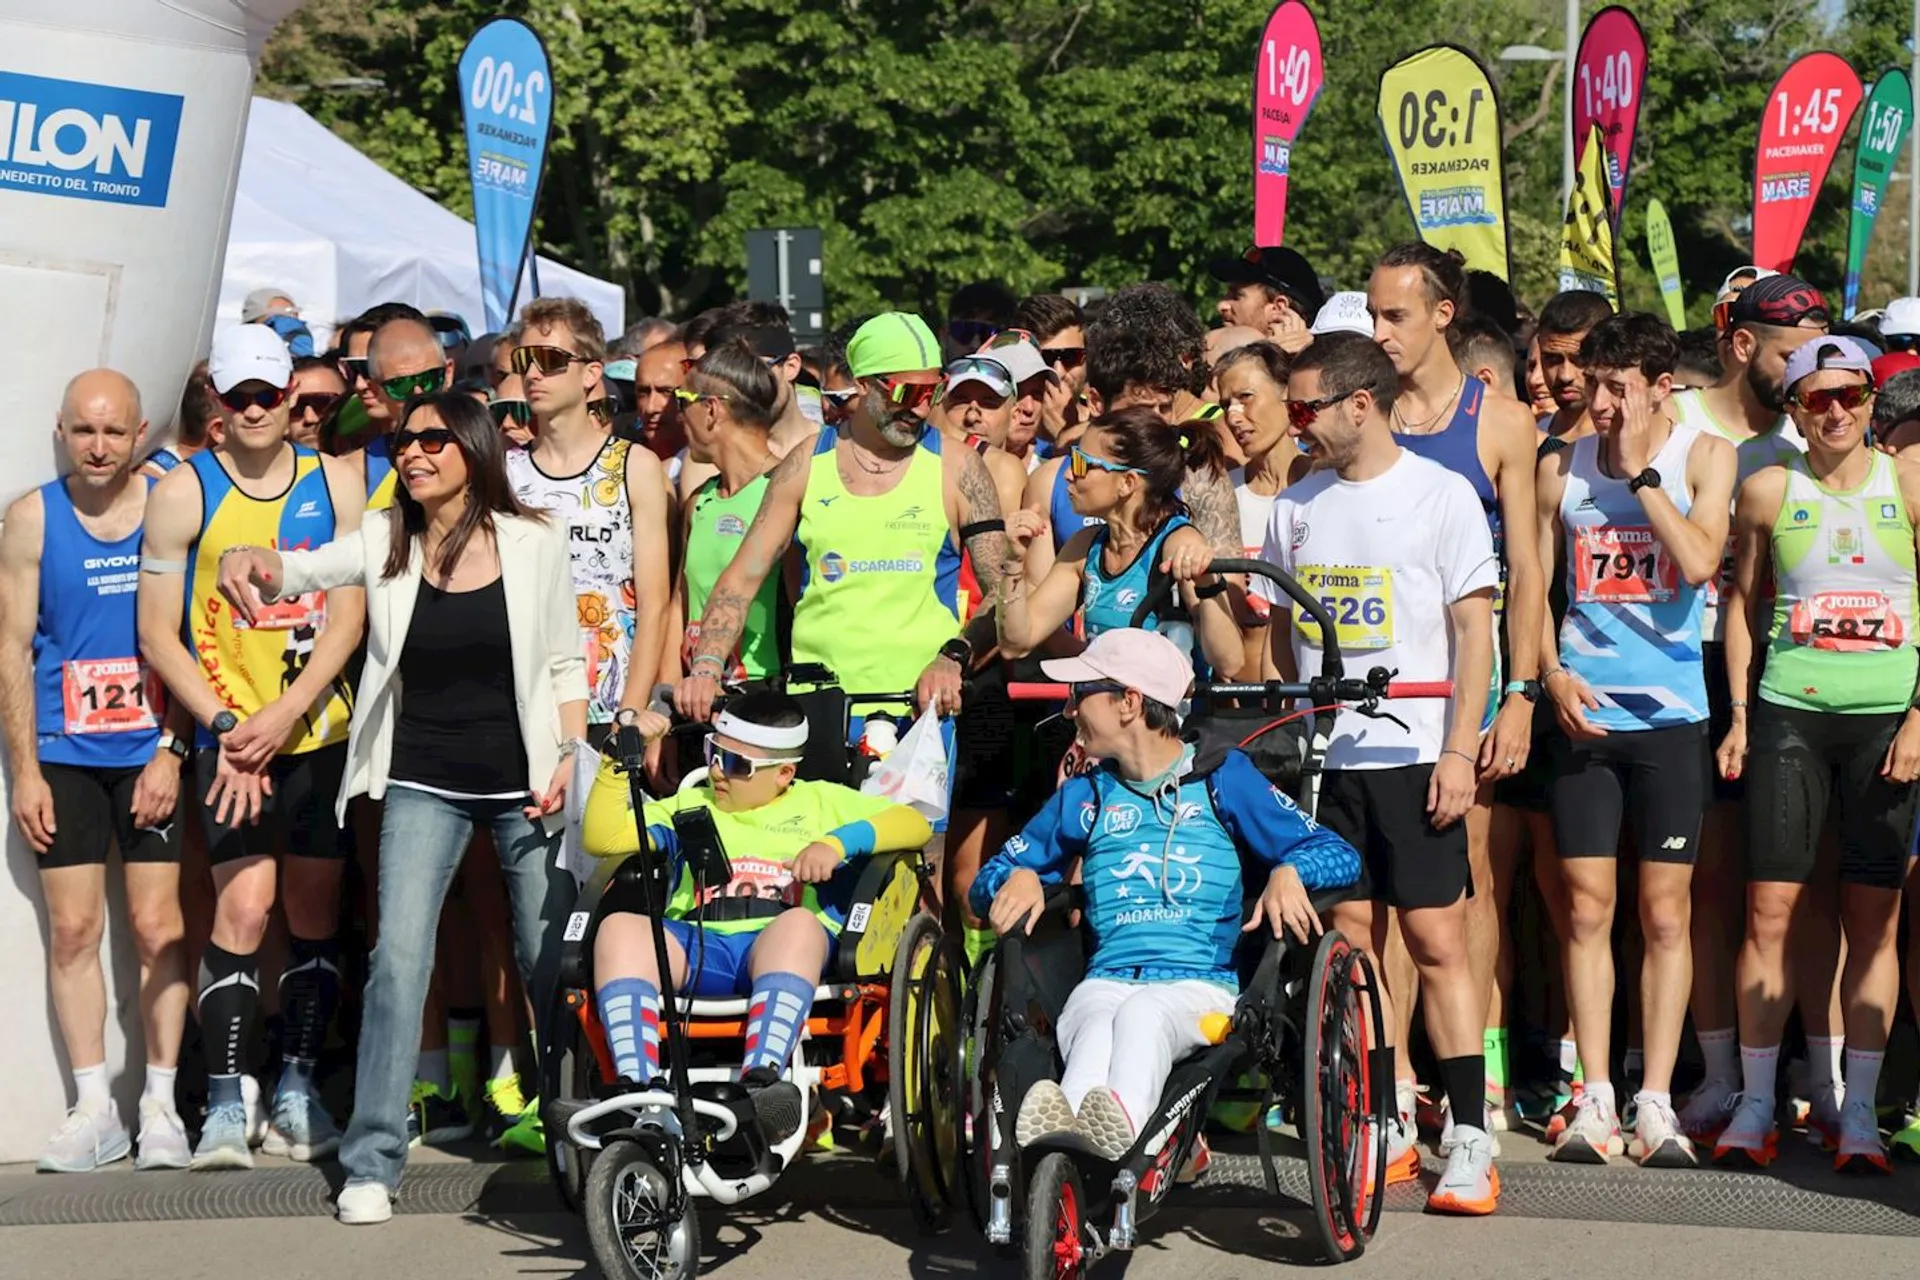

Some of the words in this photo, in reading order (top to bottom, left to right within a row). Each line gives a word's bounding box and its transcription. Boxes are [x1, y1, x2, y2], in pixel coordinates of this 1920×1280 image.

[1267, 39, 1310, 106] 1:40
[1580, 50, 1633, 118] 1:40
[1777, 88, 1842, 137] 1:45
[1865, 101, 1903, 153] 1:50
[1766, 144, 1825, 159] PACEMAKER
[64, 178, 89, 191] DEL
[93, 180, 141, 198] TRONTO
[1762, 178, 1810, 203] MARE
[849, 559, 923, 573] SCARABEO
[1592, 552, 1656, 580] 791
[1813, 619, 1885, 639] 587
[83, 682, 143, 710] 121
[1110, 821, 1133, 833] JAY
[1112, 809, 1136, 822] DEE
[227, 1016, 241, 1074] OXYBURN
